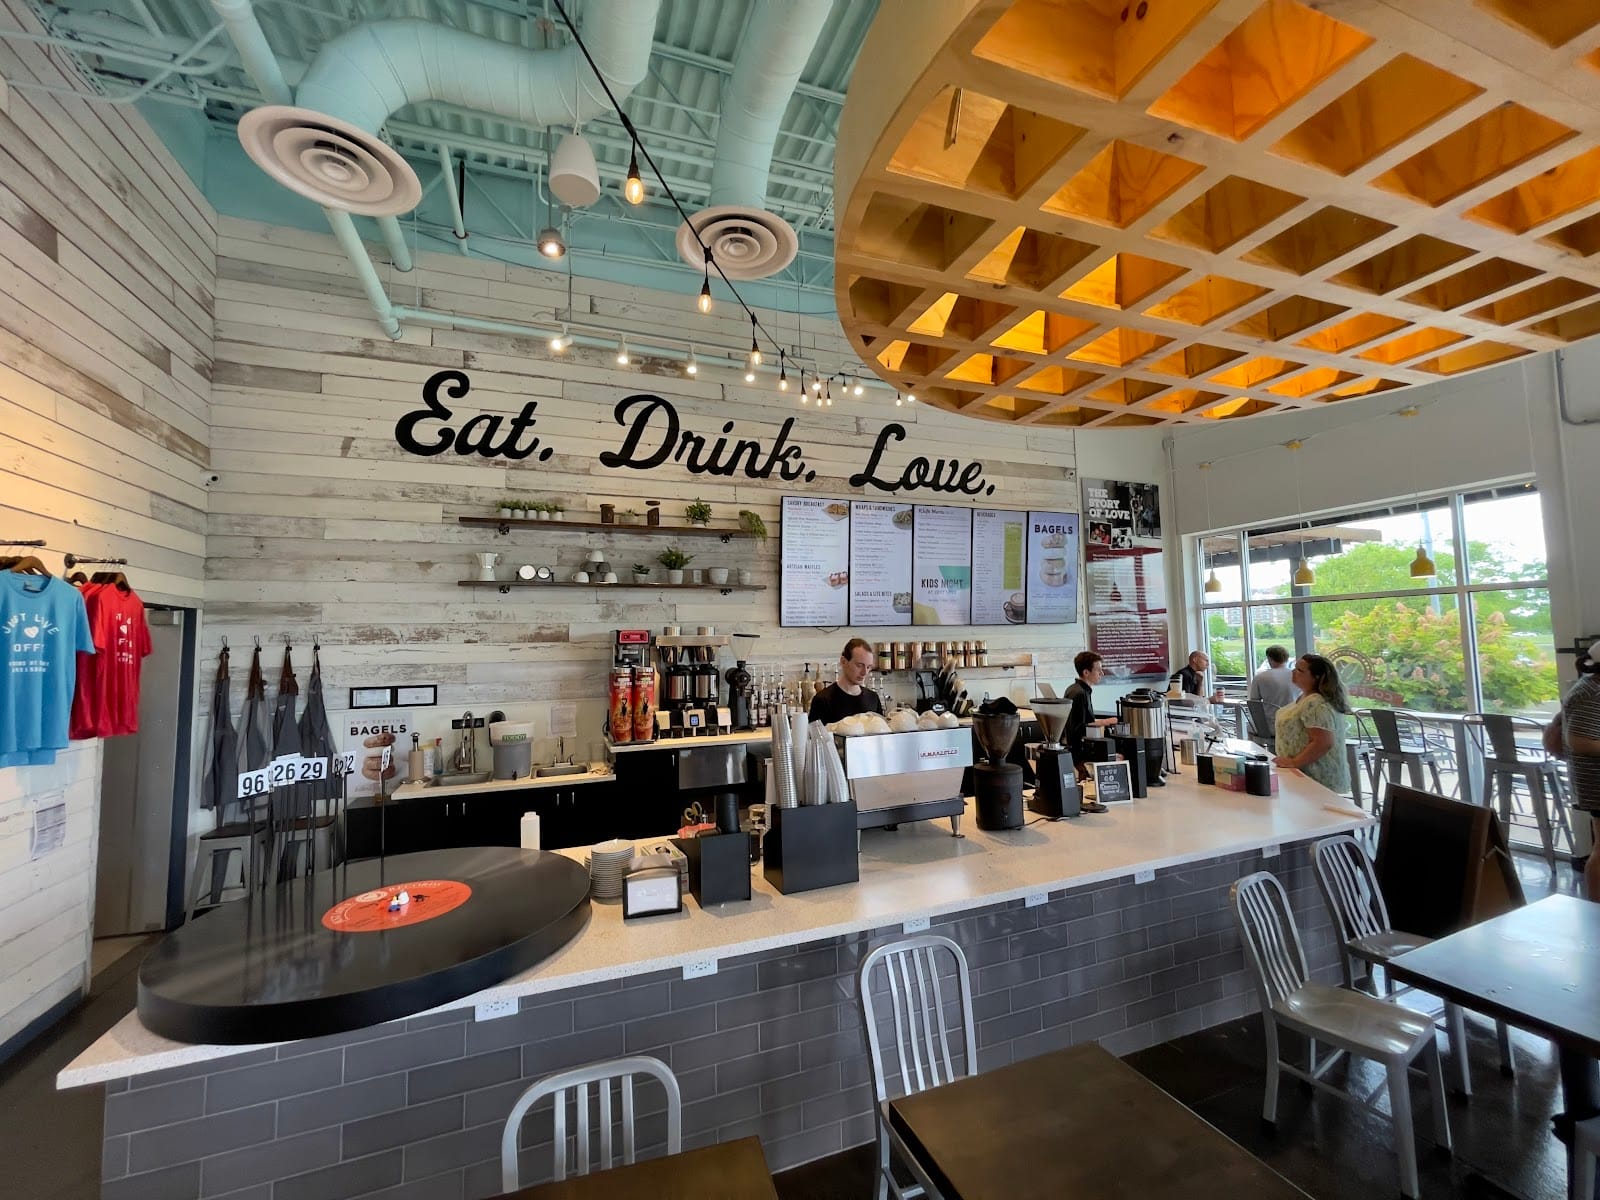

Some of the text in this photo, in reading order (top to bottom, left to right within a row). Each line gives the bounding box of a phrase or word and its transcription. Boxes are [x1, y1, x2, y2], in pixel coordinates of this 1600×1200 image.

[395, 370, 996, 495] Eat. Drink. Love.
[1088, 488, 1108, 498] THE
[1088, 499, 1120, 509] STORY
[1089, 509, 1131, 520] OF LOVE
[1034, 525, 1073, 534] BAGELS
[921, 578, 964, 589] KIDS NIGHT
[350, 725, 407, 736] BAGELS
[274, 763, 295, 781] 26
[300, 762, 323, 779] 29
[242, 774, 264, 795] 96
